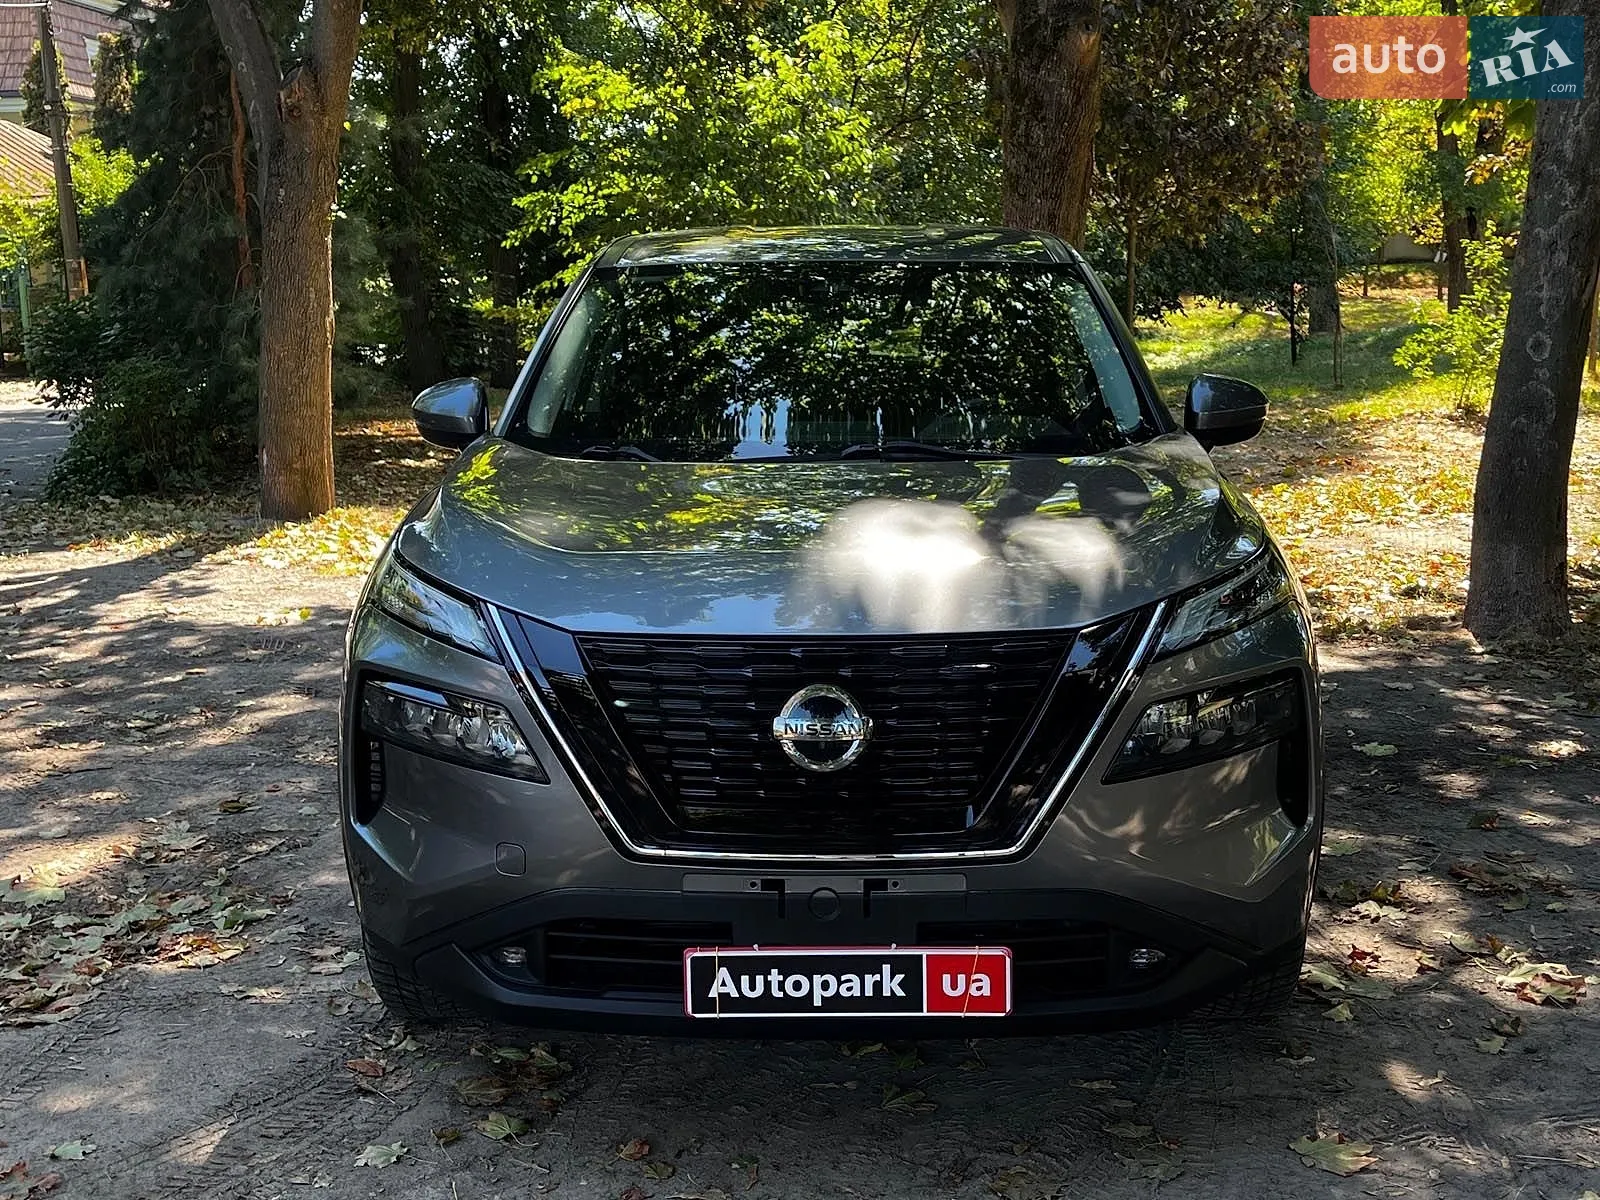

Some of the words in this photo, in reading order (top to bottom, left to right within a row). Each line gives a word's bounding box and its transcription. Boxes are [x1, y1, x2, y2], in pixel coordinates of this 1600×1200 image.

[784, 723, 863, 736] NISSAN
[707, 964, 906, 1007] Autopark
[941, 971, 992, 997] ua
